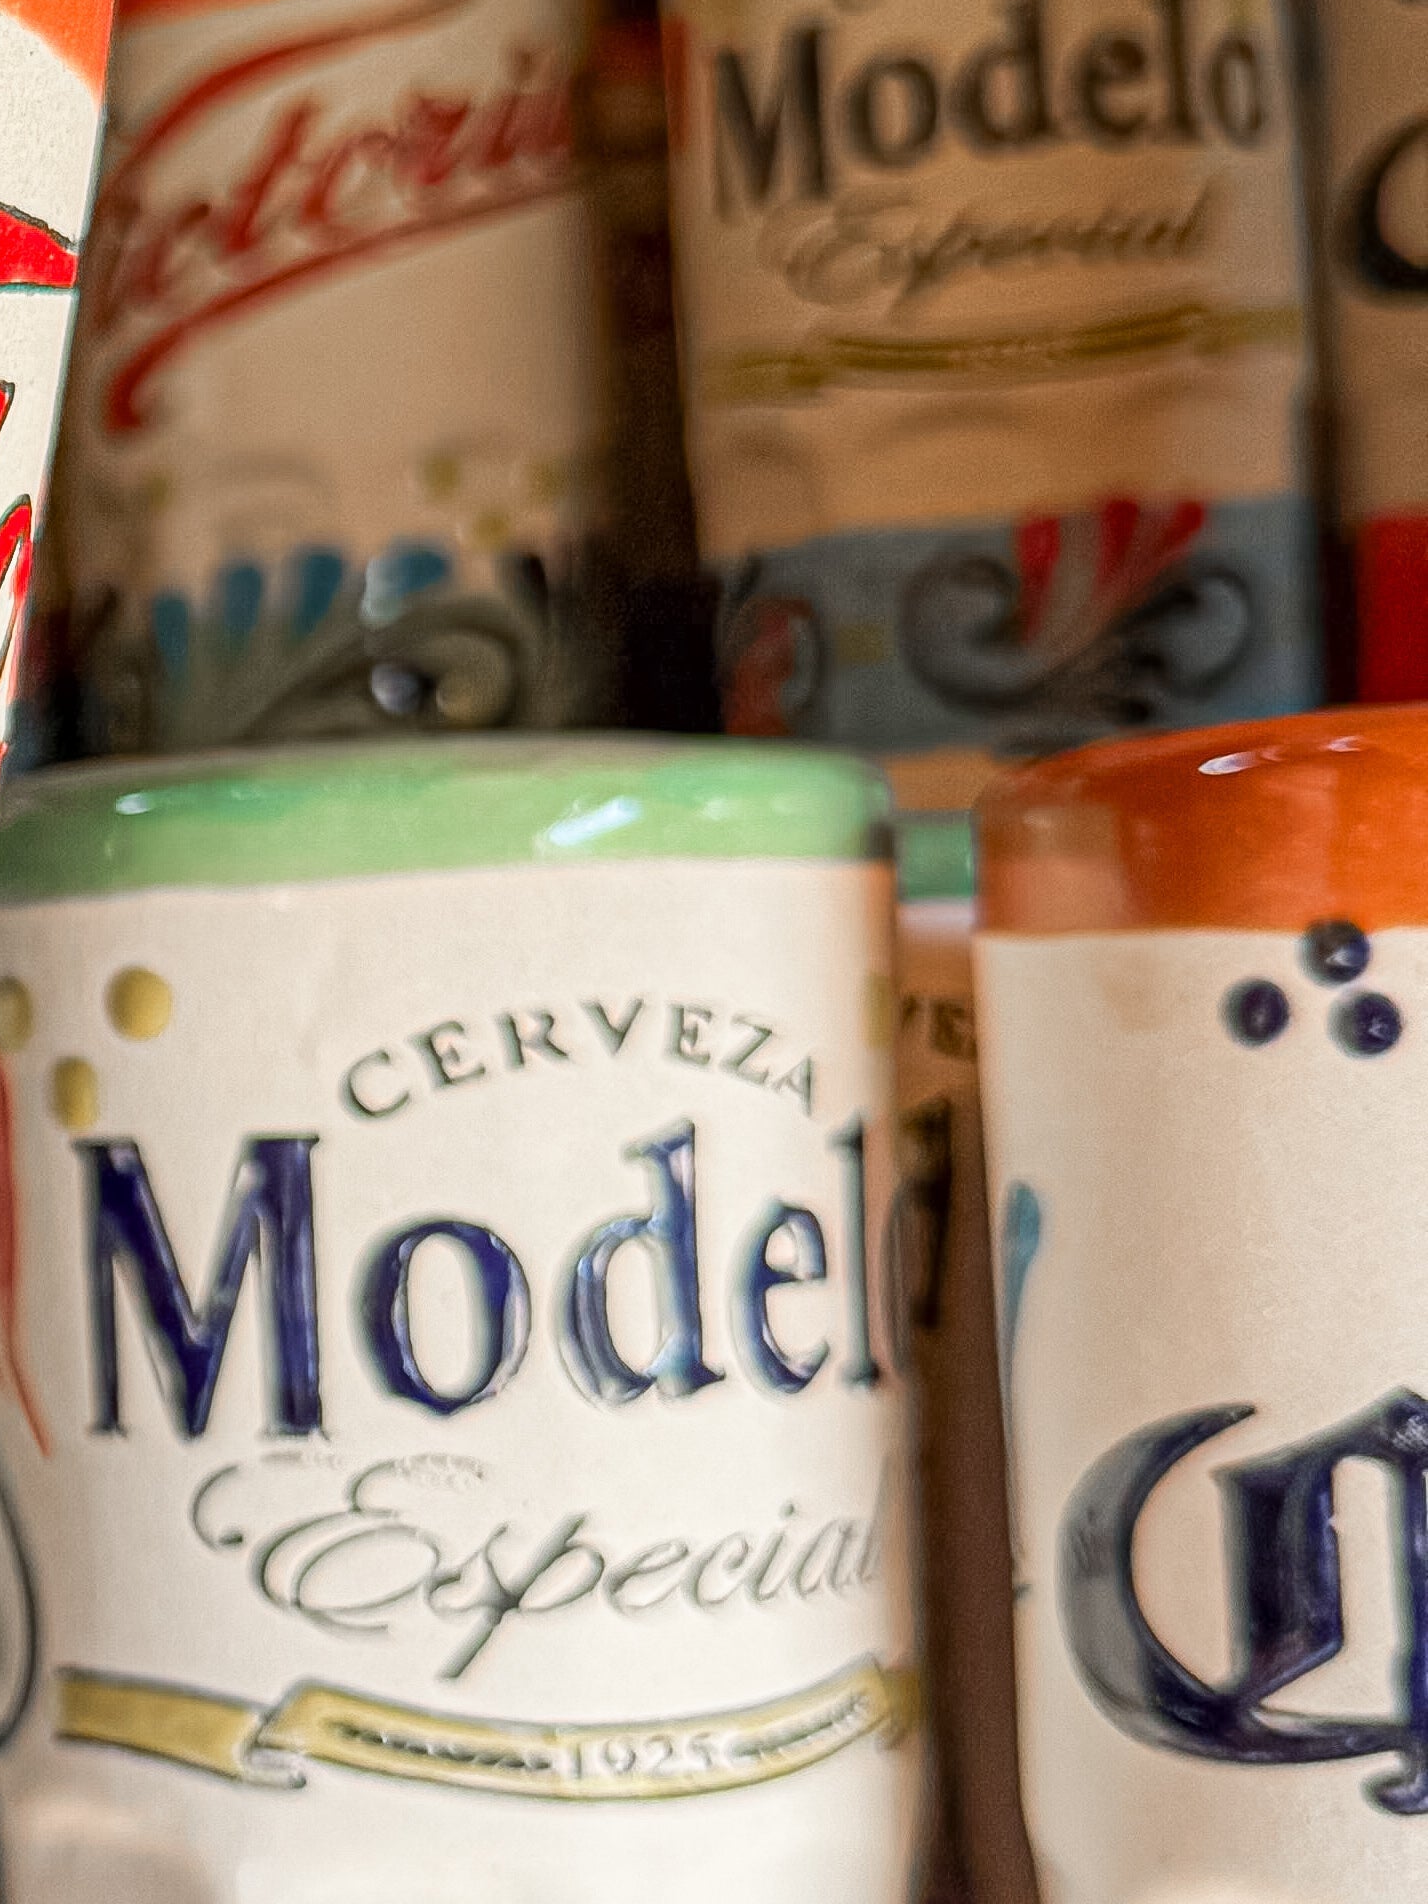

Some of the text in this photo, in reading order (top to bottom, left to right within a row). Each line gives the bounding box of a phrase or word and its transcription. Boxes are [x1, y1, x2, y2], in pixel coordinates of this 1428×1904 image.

[340, 996, 822, 1120] CERVEZA
[73, 1116, 910, 1442] Model
[190, 1450, 896, 1682] Especial
